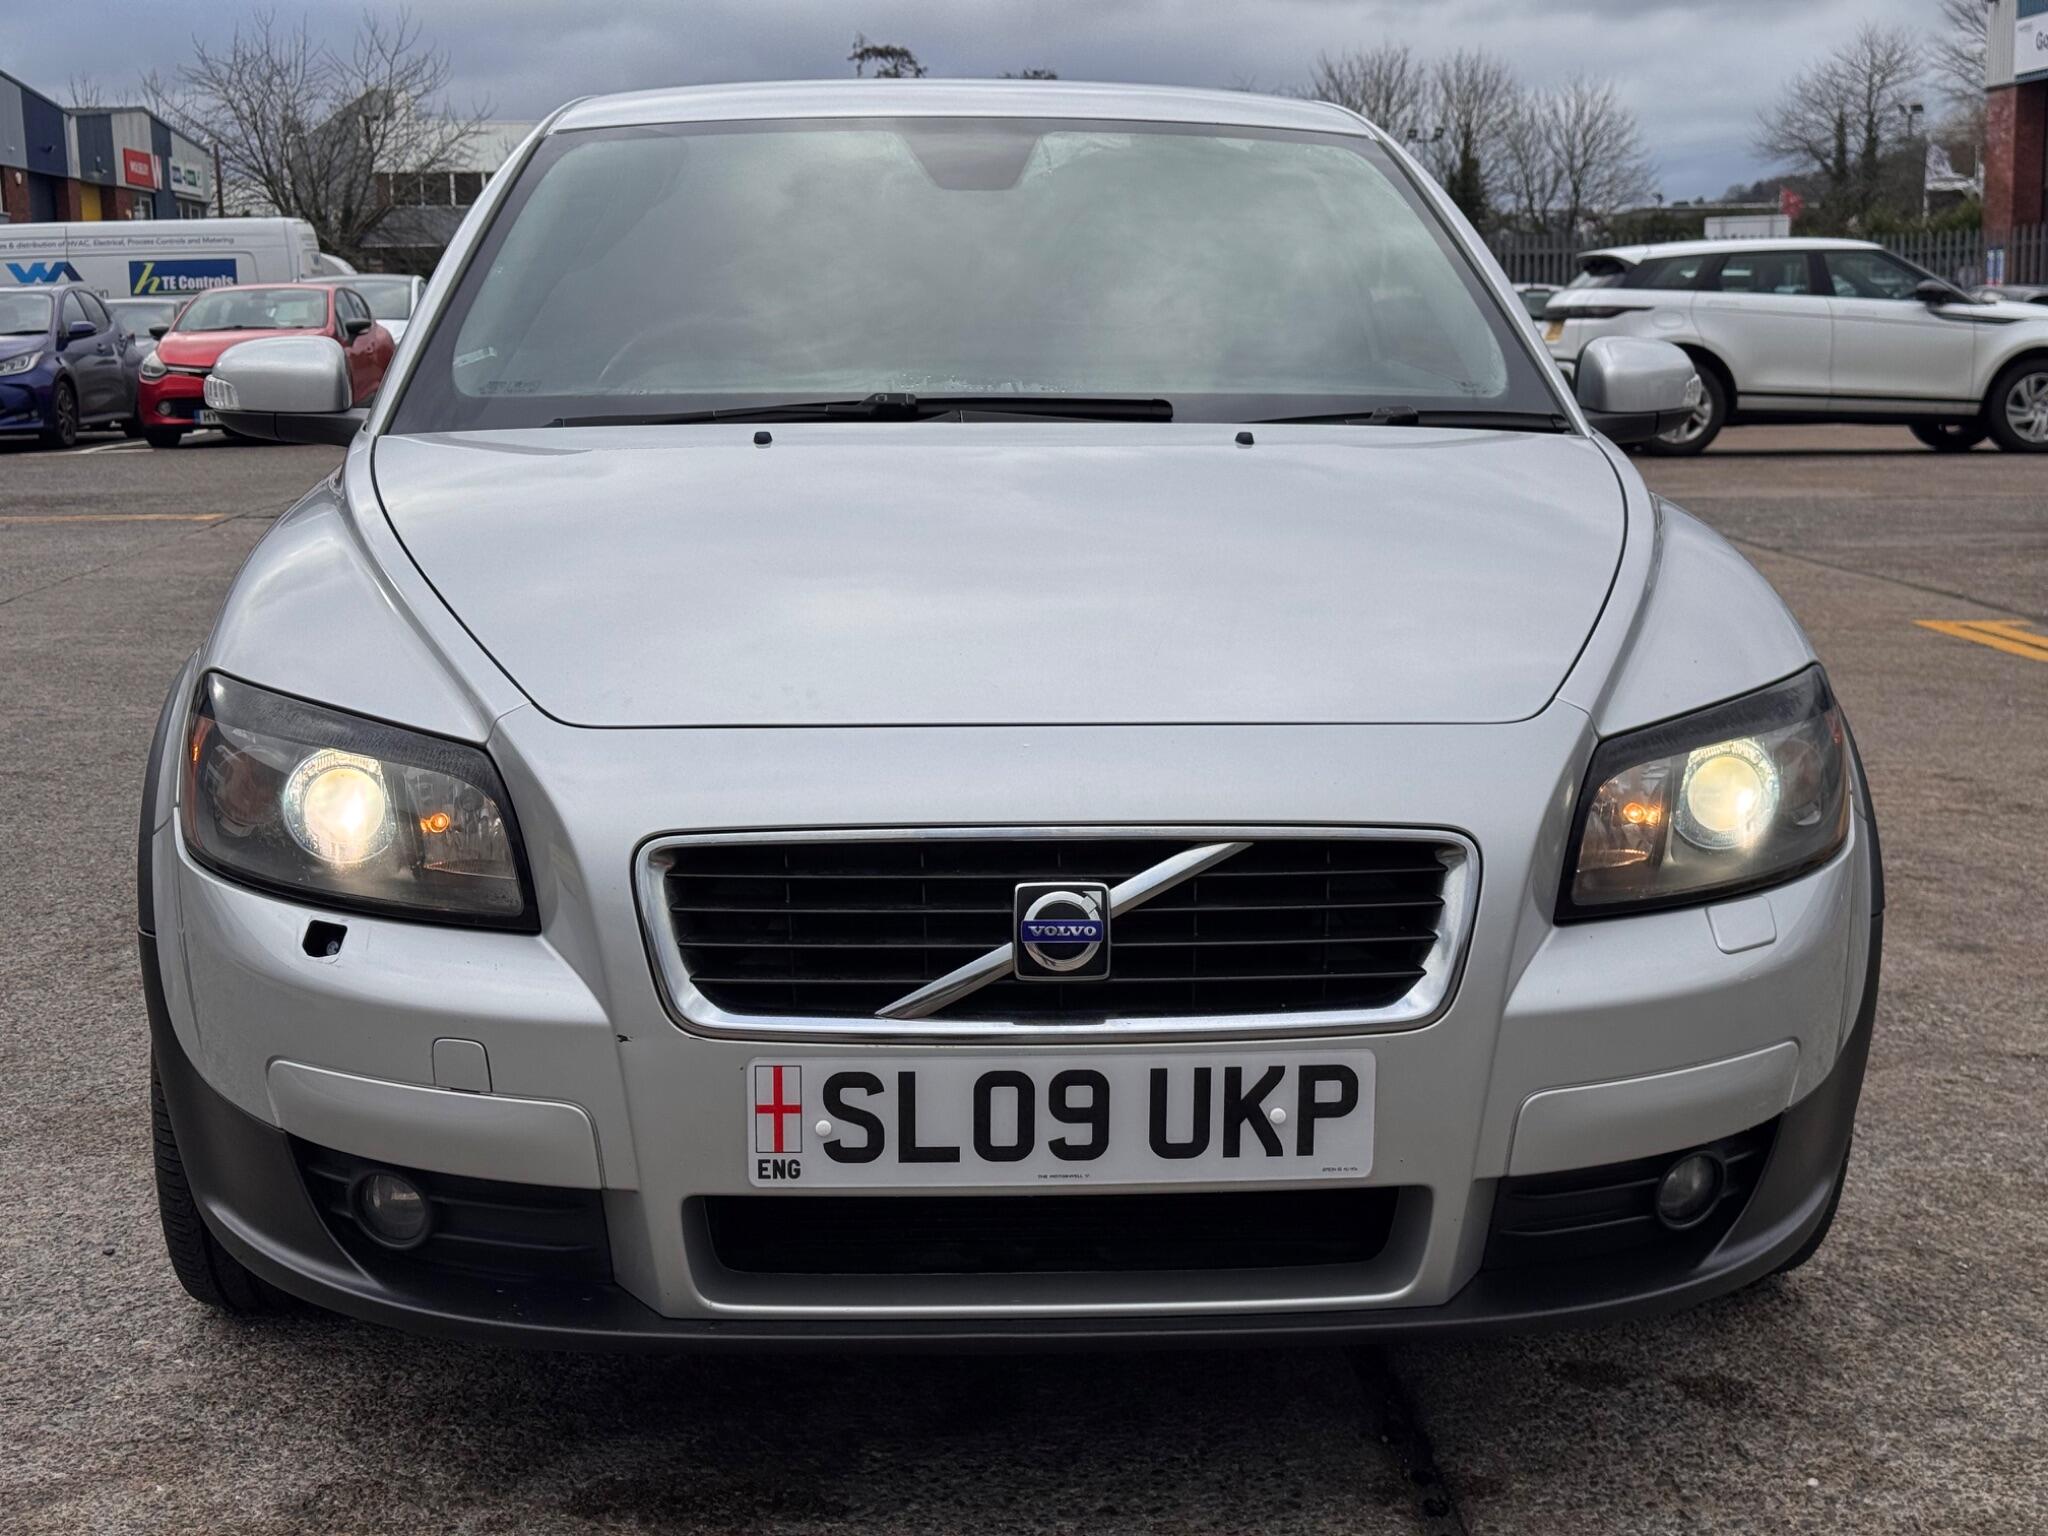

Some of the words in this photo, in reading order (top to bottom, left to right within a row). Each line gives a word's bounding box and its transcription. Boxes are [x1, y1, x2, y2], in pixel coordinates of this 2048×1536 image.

[178, 274, 234, 290] Controls
[1028, 925, 1097, 936] VOLVO
[823, 1069, 1110, 1164] SL09
[1149, 1064, 1359, 1160] UKP
[757, 1159, 801, 1180] ENG
